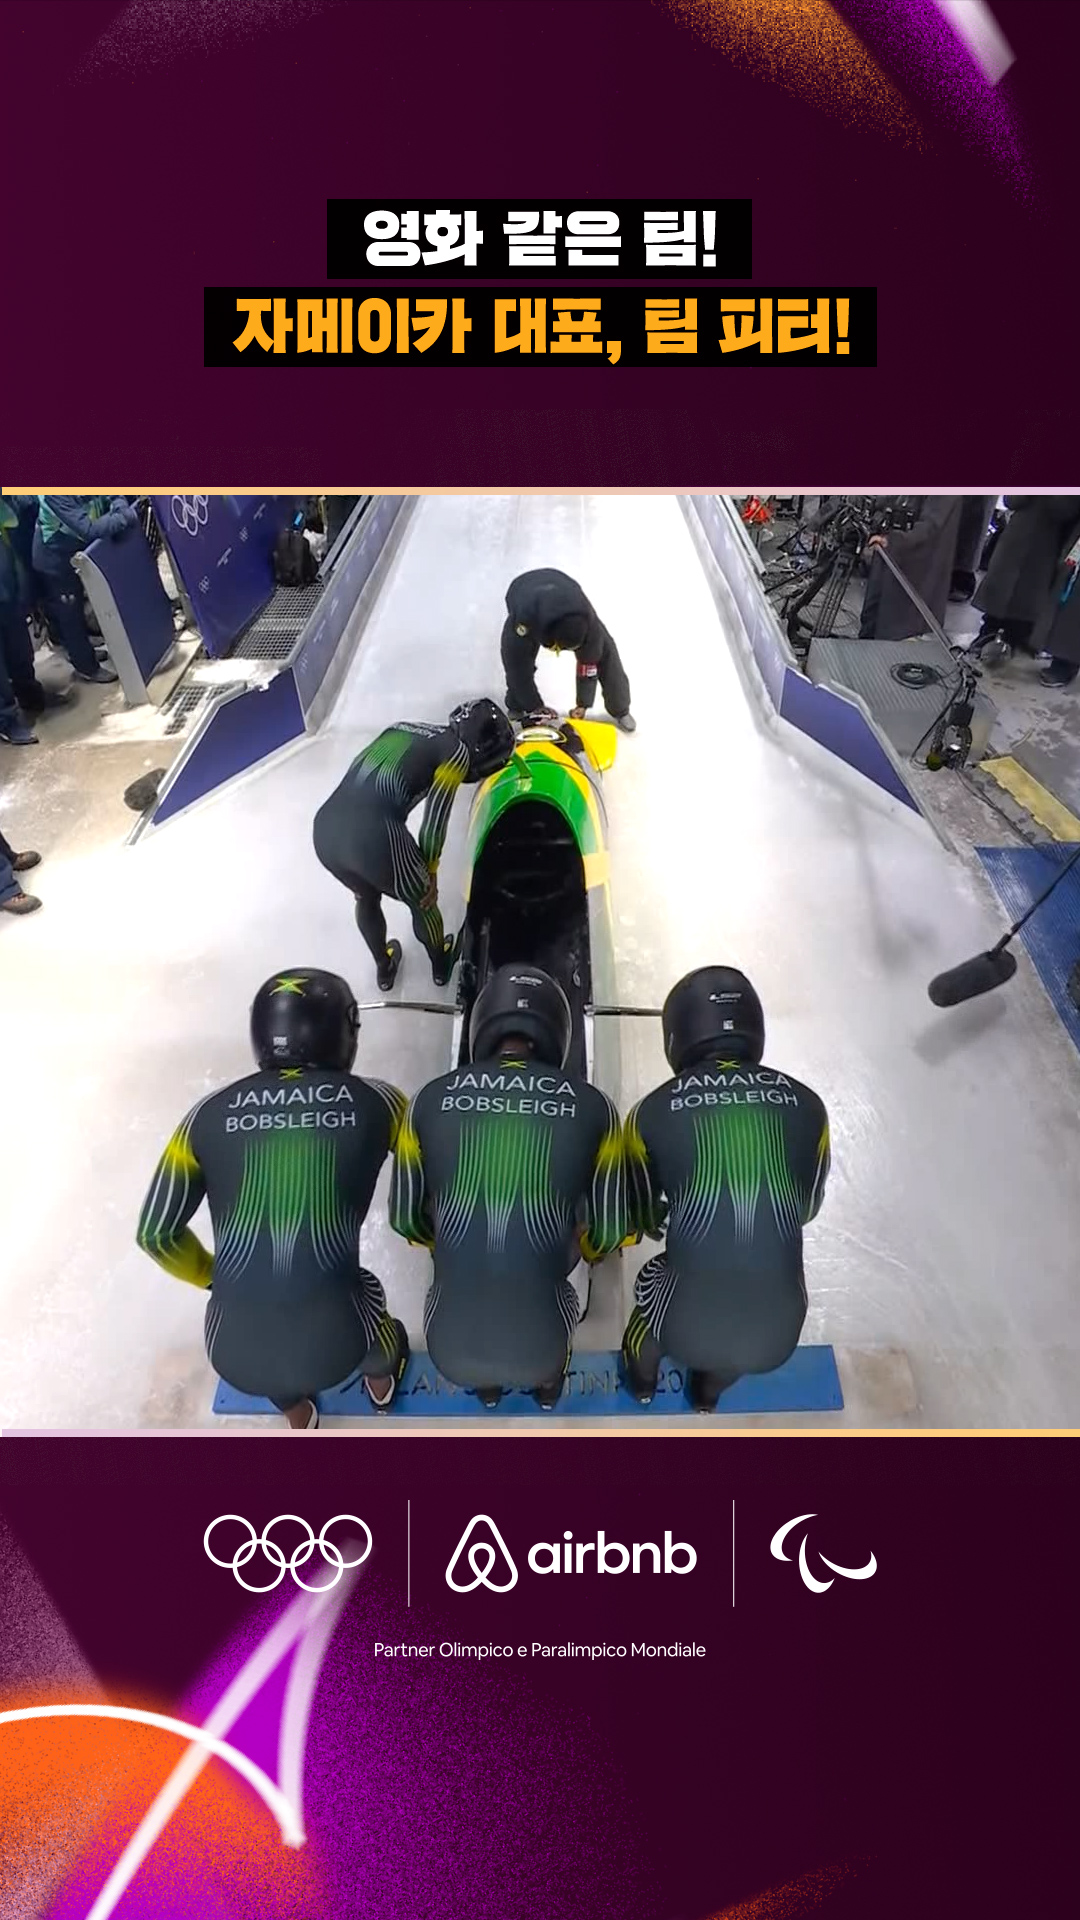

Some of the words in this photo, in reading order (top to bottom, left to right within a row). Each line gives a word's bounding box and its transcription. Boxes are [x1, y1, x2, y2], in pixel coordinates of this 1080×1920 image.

[446, 1072, 577, 1098] JAMAICA
[671, 1071, 793, 1094] JAMAICA
[228, 1083, 354, 1109] JAMAICA
[441, 1095, 576, 1118] BOBSLEIGH
[670, 1088, 799, 1112] BOBSLEIGH
[225, 1110, 357, 1133] BOBSLEIGH
